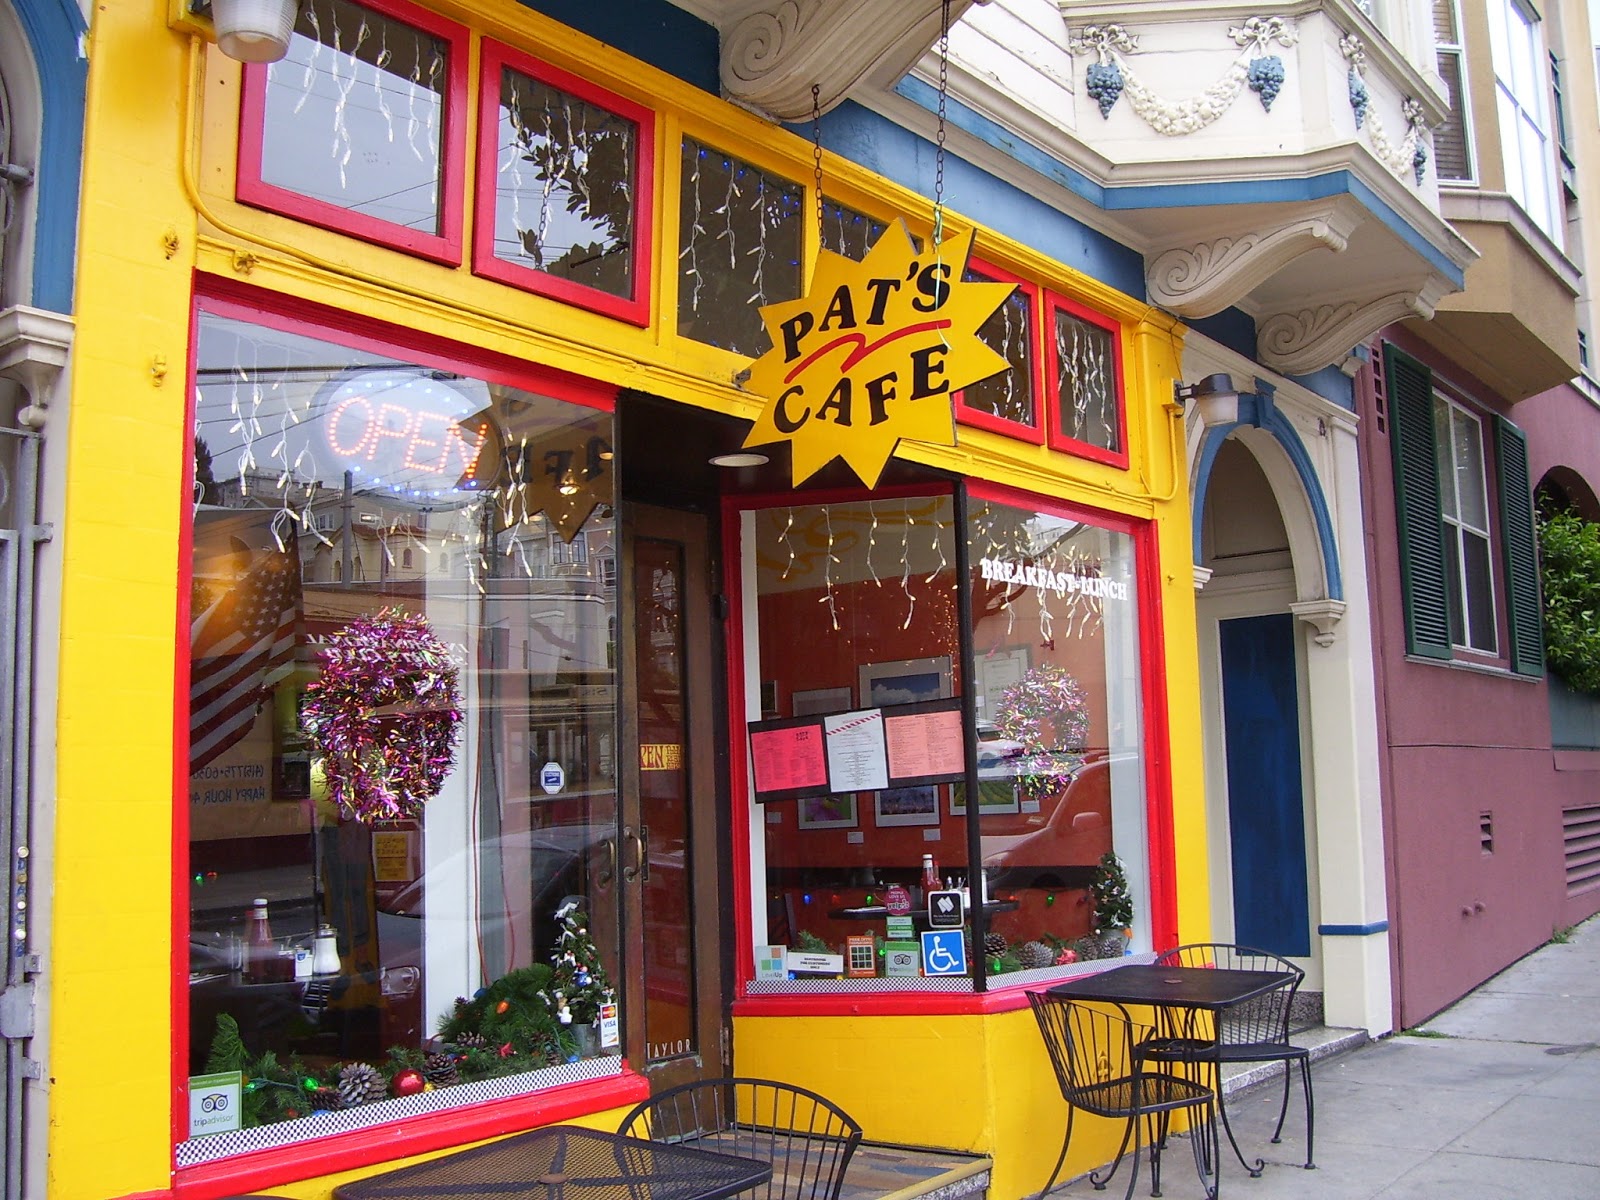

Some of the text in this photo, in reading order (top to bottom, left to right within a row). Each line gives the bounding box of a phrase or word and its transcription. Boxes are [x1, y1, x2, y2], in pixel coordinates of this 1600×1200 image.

[780, 261, 951, 363] PAT'S
[772, 344, 951, 433] CAFE
[328, 394, 489, 479] OPEN
[603, 1020, 616, 1029] VISA
[646, 1039, 691, 1060] TAYLOR
[193, 1114, 234, 1127] tripadvisor
